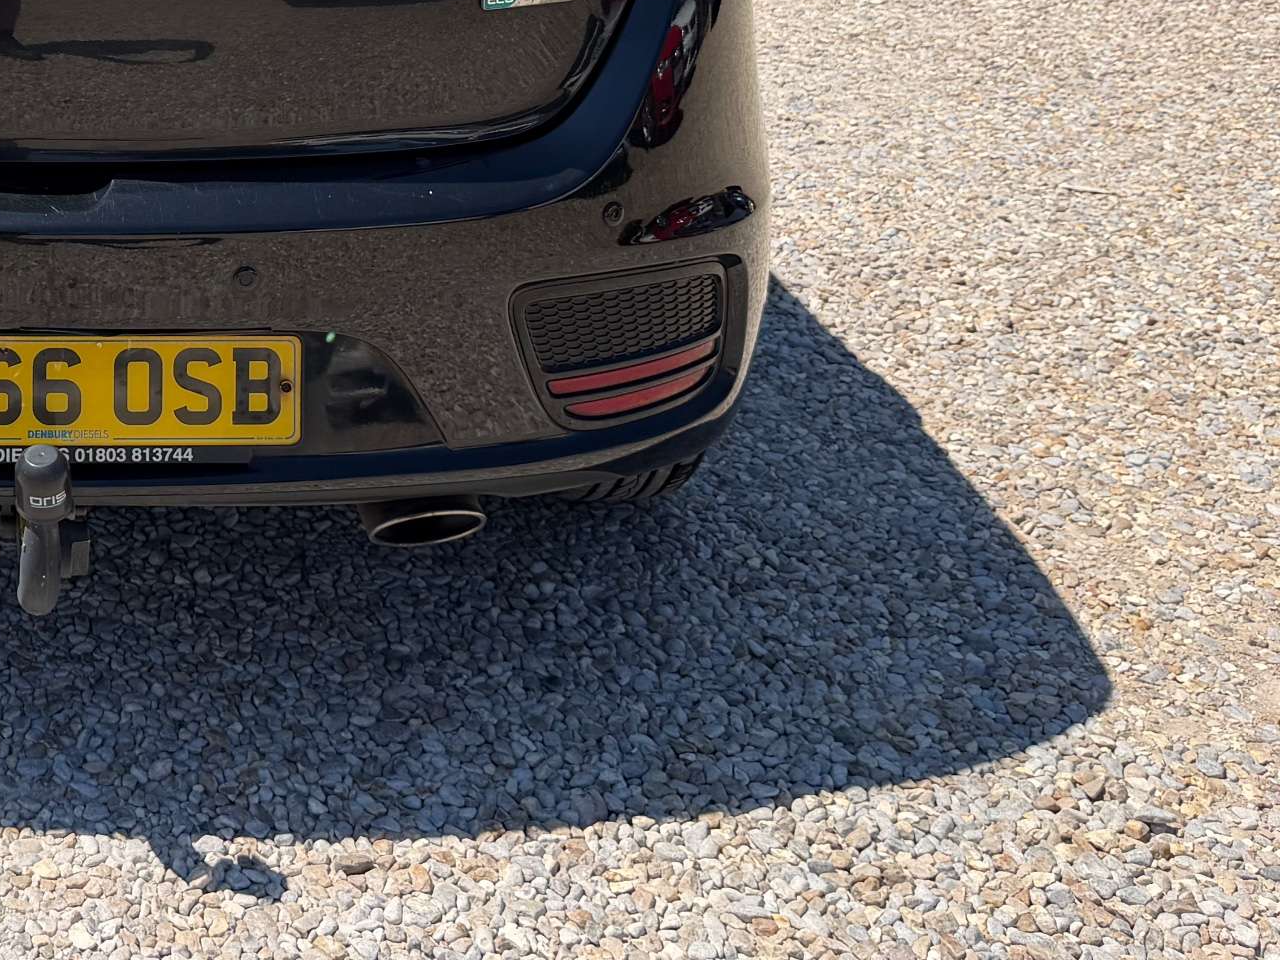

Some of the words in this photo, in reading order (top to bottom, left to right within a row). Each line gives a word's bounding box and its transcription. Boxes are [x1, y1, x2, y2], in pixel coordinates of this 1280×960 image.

[113, 347, 282, 426] OSB
[75, 448, 127, 462] 01803
[131, 447, 194, 462] 813744
